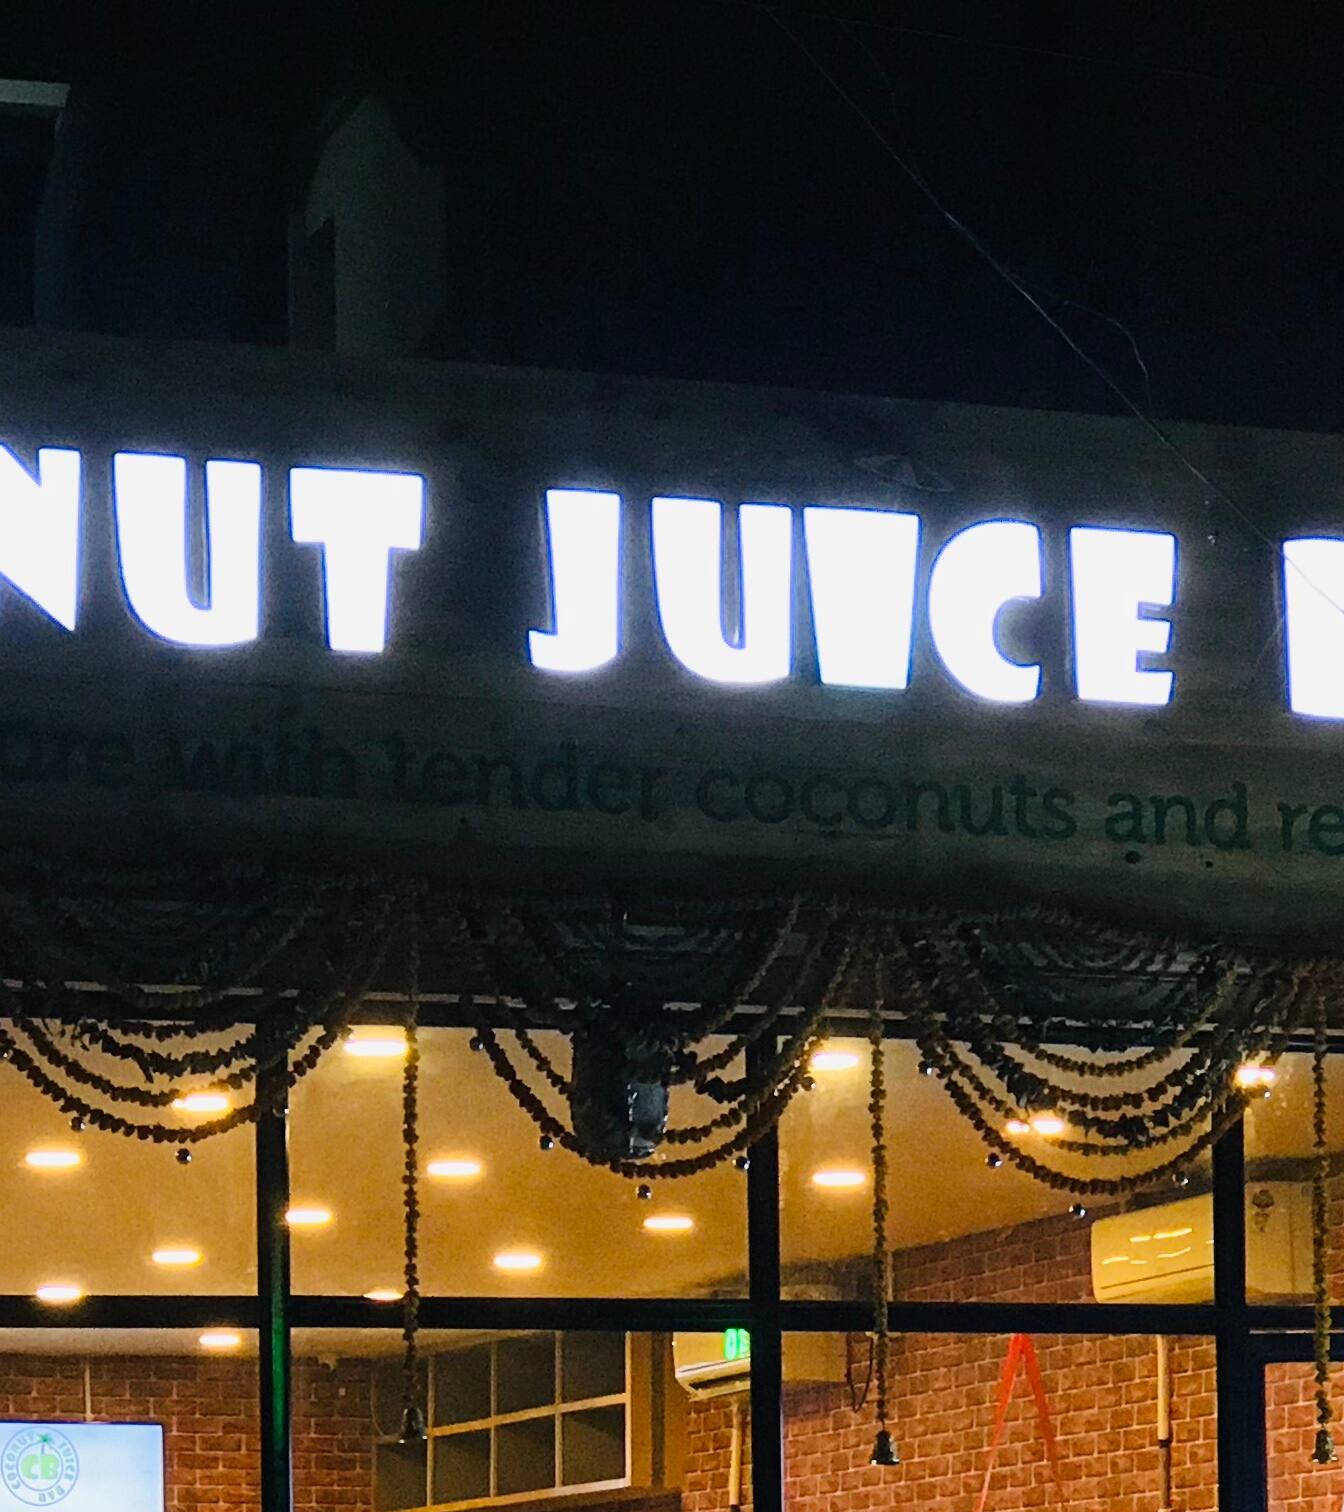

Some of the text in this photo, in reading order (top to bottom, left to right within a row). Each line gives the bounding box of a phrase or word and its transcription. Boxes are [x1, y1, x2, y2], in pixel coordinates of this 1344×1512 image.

[528, 487, 1177, 708] JUICE
[164, 722, 356, 797] with
[383, 732, 667, 817] tender
[694, 767, 1078, 840] coconuts
[1104, 782, 1254, 851] and
[20, 1454, 60, 1480] CB
